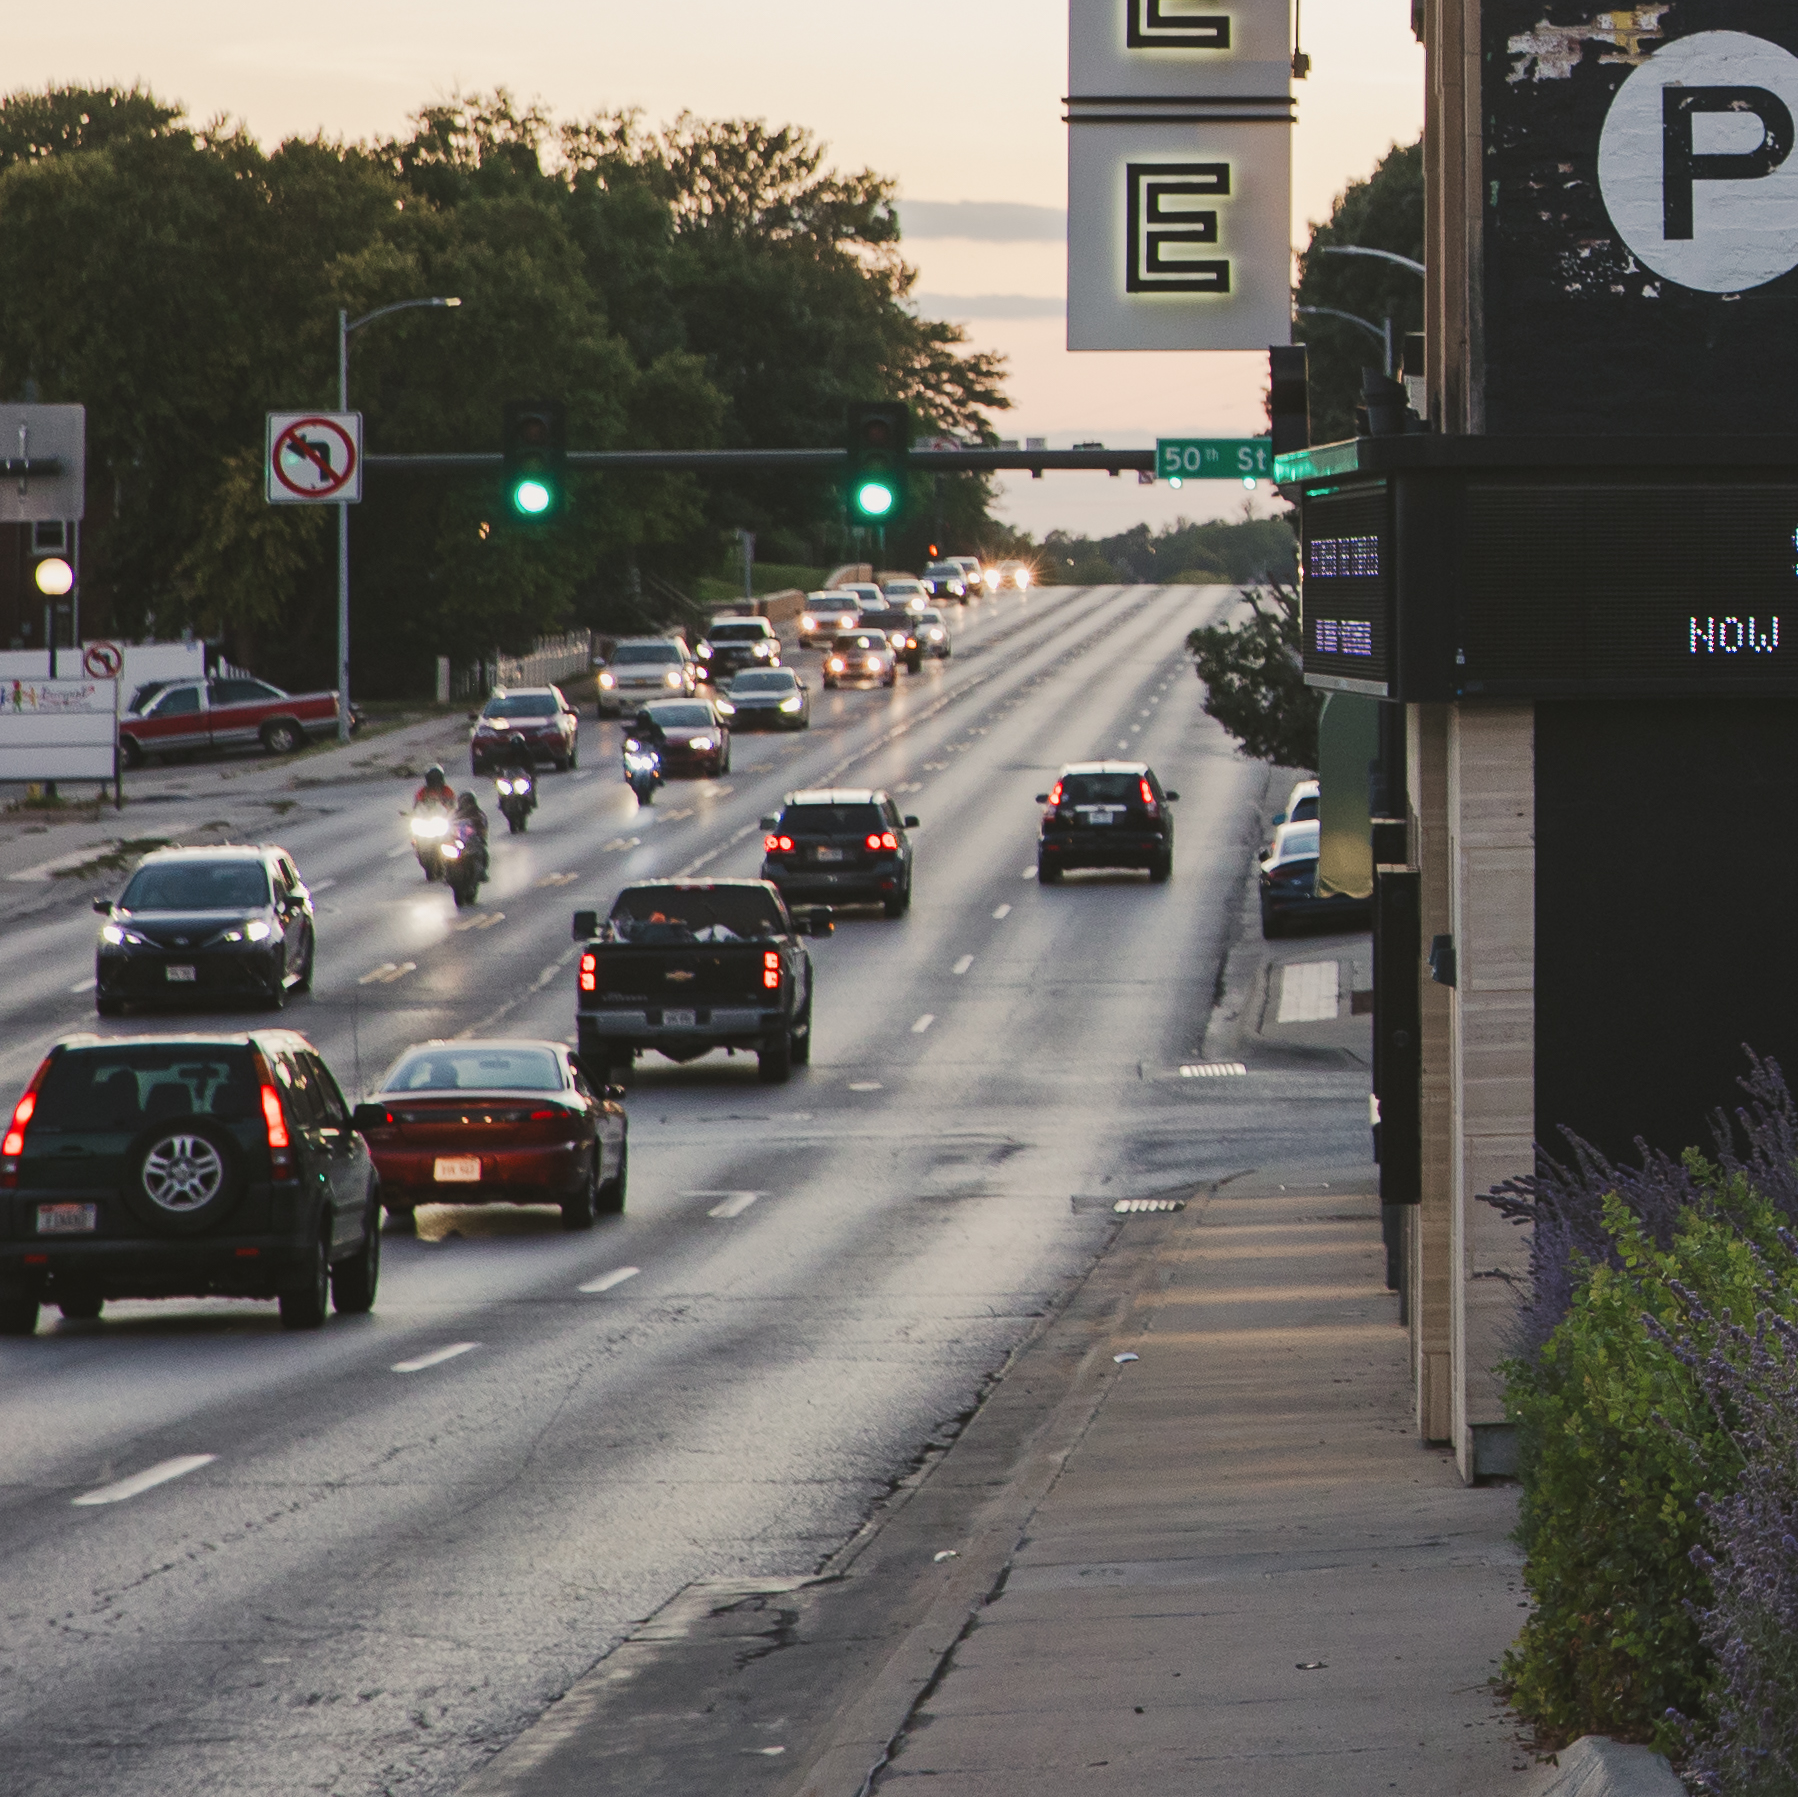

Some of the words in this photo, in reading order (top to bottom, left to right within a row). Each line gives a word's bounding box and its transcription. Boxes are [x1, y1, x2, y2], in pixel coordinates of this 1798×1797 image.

[1661, 83, 1797, 241] P
[1164, 446, 1220, 471] 50th
[1238, 446, 1267, 472] St
[1688, 615, 1780, 654] NOW
